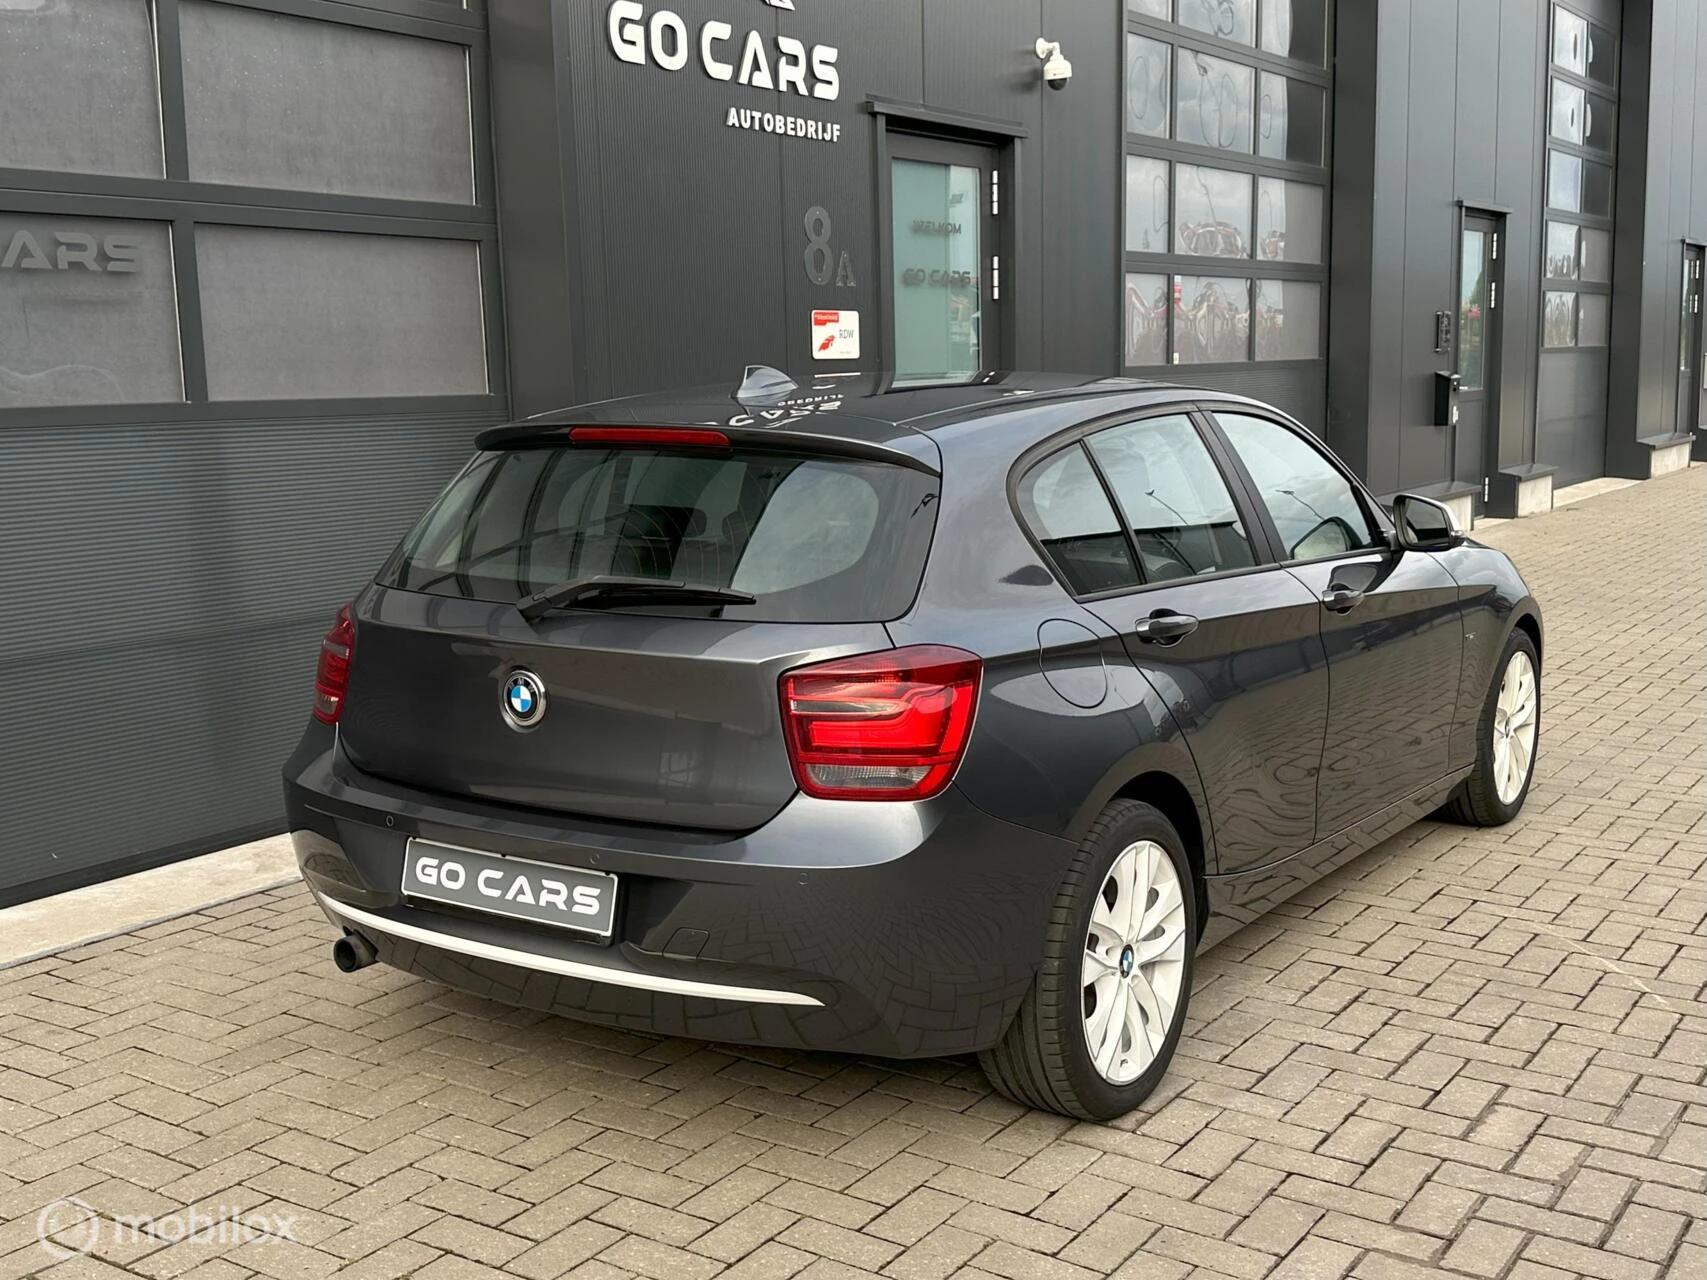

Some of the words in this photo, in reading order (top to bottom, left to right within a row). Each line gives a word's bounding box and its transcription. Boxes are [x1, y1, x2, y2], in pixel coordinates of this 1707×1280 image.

[608, 0, 688, 71] GO
[702, 20, 839, 100] CARS
[727, 107, 841, 142] AUTOBEDRIJF
[911, 220, 962, 235] WELKOM
[0, 230, 138, 272] ARS
[903, 268, 925, 286] GO
[415, 856, 466, 890] GO
[477, 868, 601, 916] CARS
